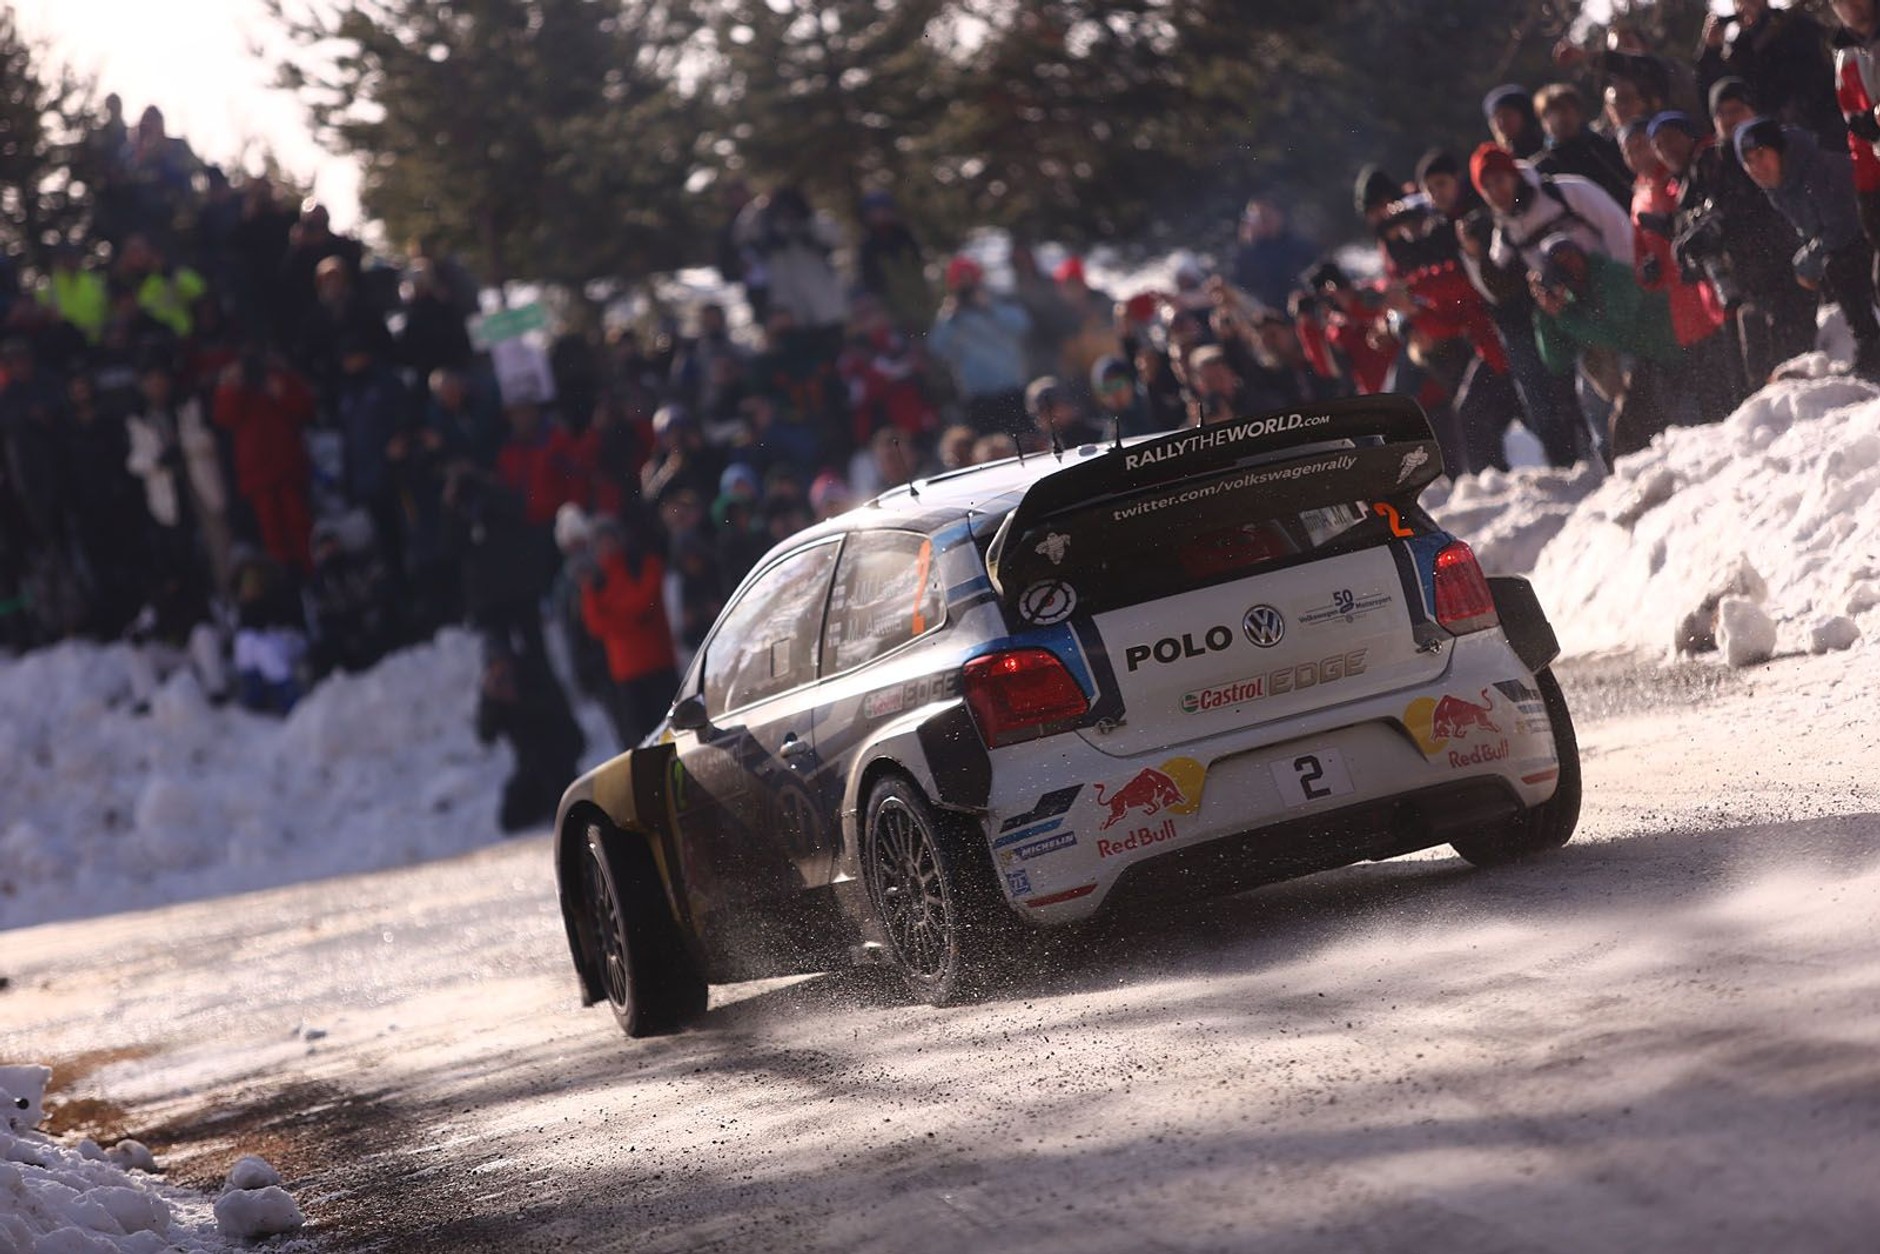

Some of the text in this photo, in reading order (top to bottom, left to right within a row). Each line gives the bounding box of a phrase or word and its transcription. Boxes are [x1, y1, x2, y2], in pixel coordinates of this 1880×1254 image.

[1113, 455, 1358, 522] twitter.com/volkswagenrally
[1373, 502, 1415, 538] 2
[1332, 589, 1354, 607] 50
[1125, 625, 1233, 673] POLO
[1200, 648, 1368, 710] Castrol EDGE
[1448, 737, 1509, 769] Red Bull
[1293, 755, 1332, 800] 2
[1021, 834, 1074, 857] MICHELIN
[1096, 819, 1178, 858] Red Bull
